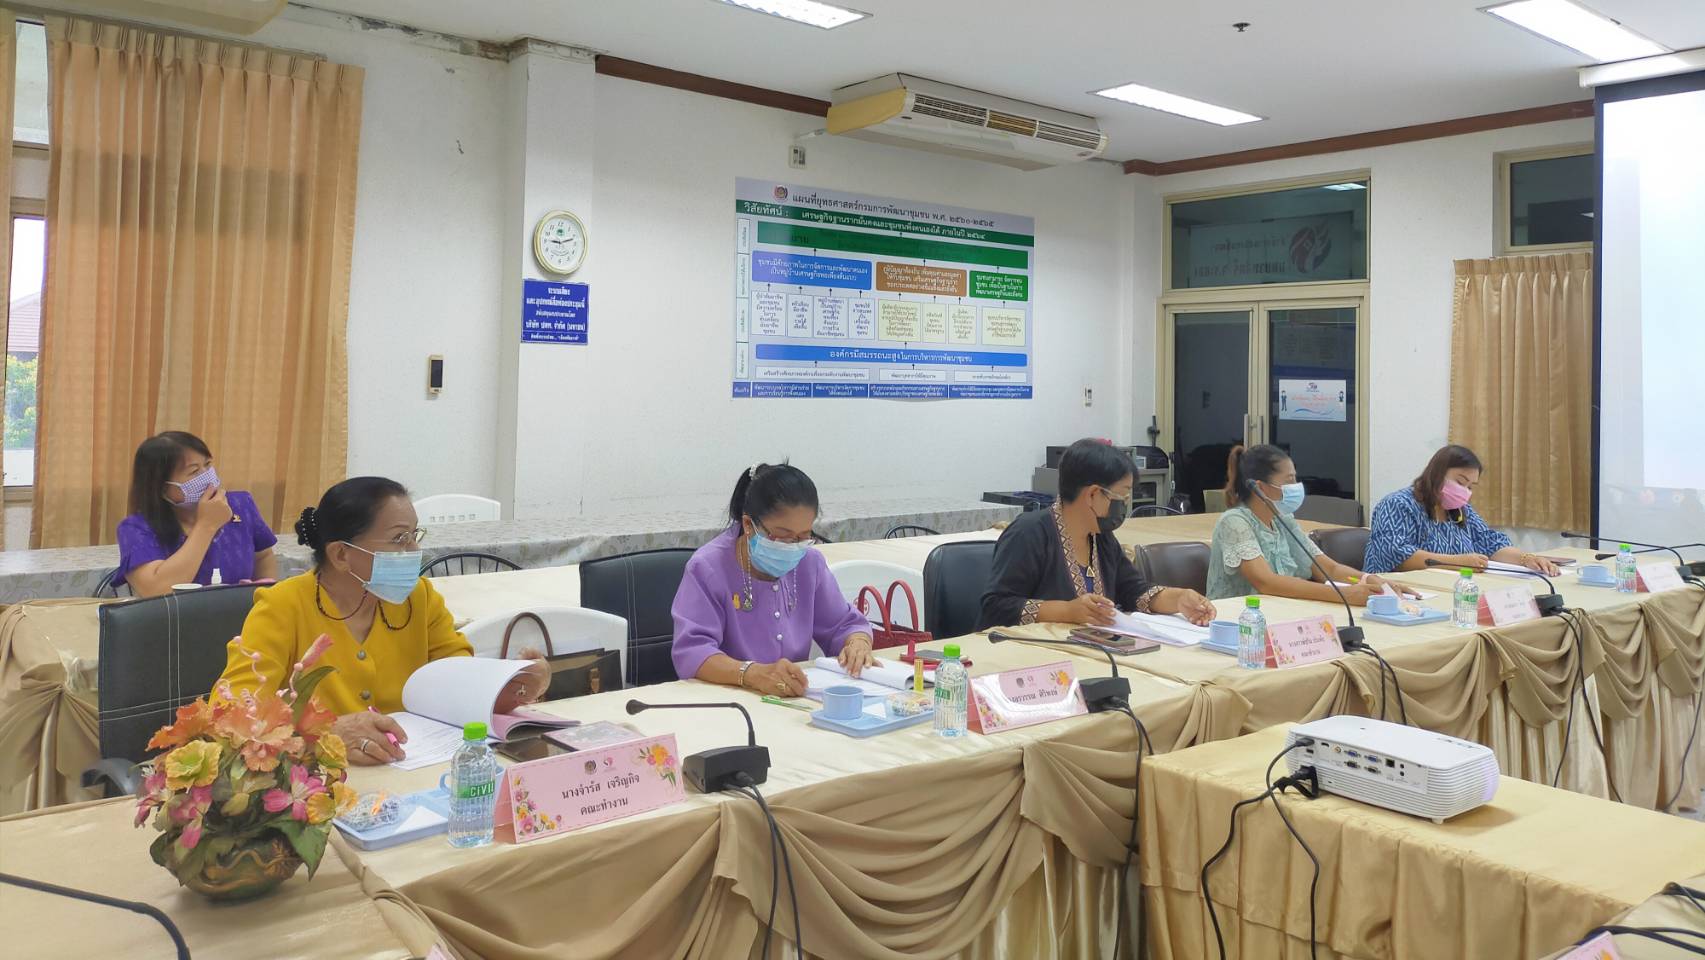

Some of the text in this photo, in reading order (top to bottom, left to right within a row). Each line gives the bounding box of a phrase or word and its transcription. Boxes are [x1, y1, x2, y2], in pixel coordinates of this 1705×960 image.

[743, 201, 783, 217] วิสัยทัศน์
[792, 192, 930, 220] แผนที่ยุทธศาสตร์กรมการพัฒนาชุมชน
[829, 349, 973, 364] องค์กรมีสมรรถนะสูงในการบริหารการพัฒนาชุมชน
[561, 772, 641, 799] นางจำรัส เจริญกิจ
[580, 796, 629, 816] คณะทำงาน
